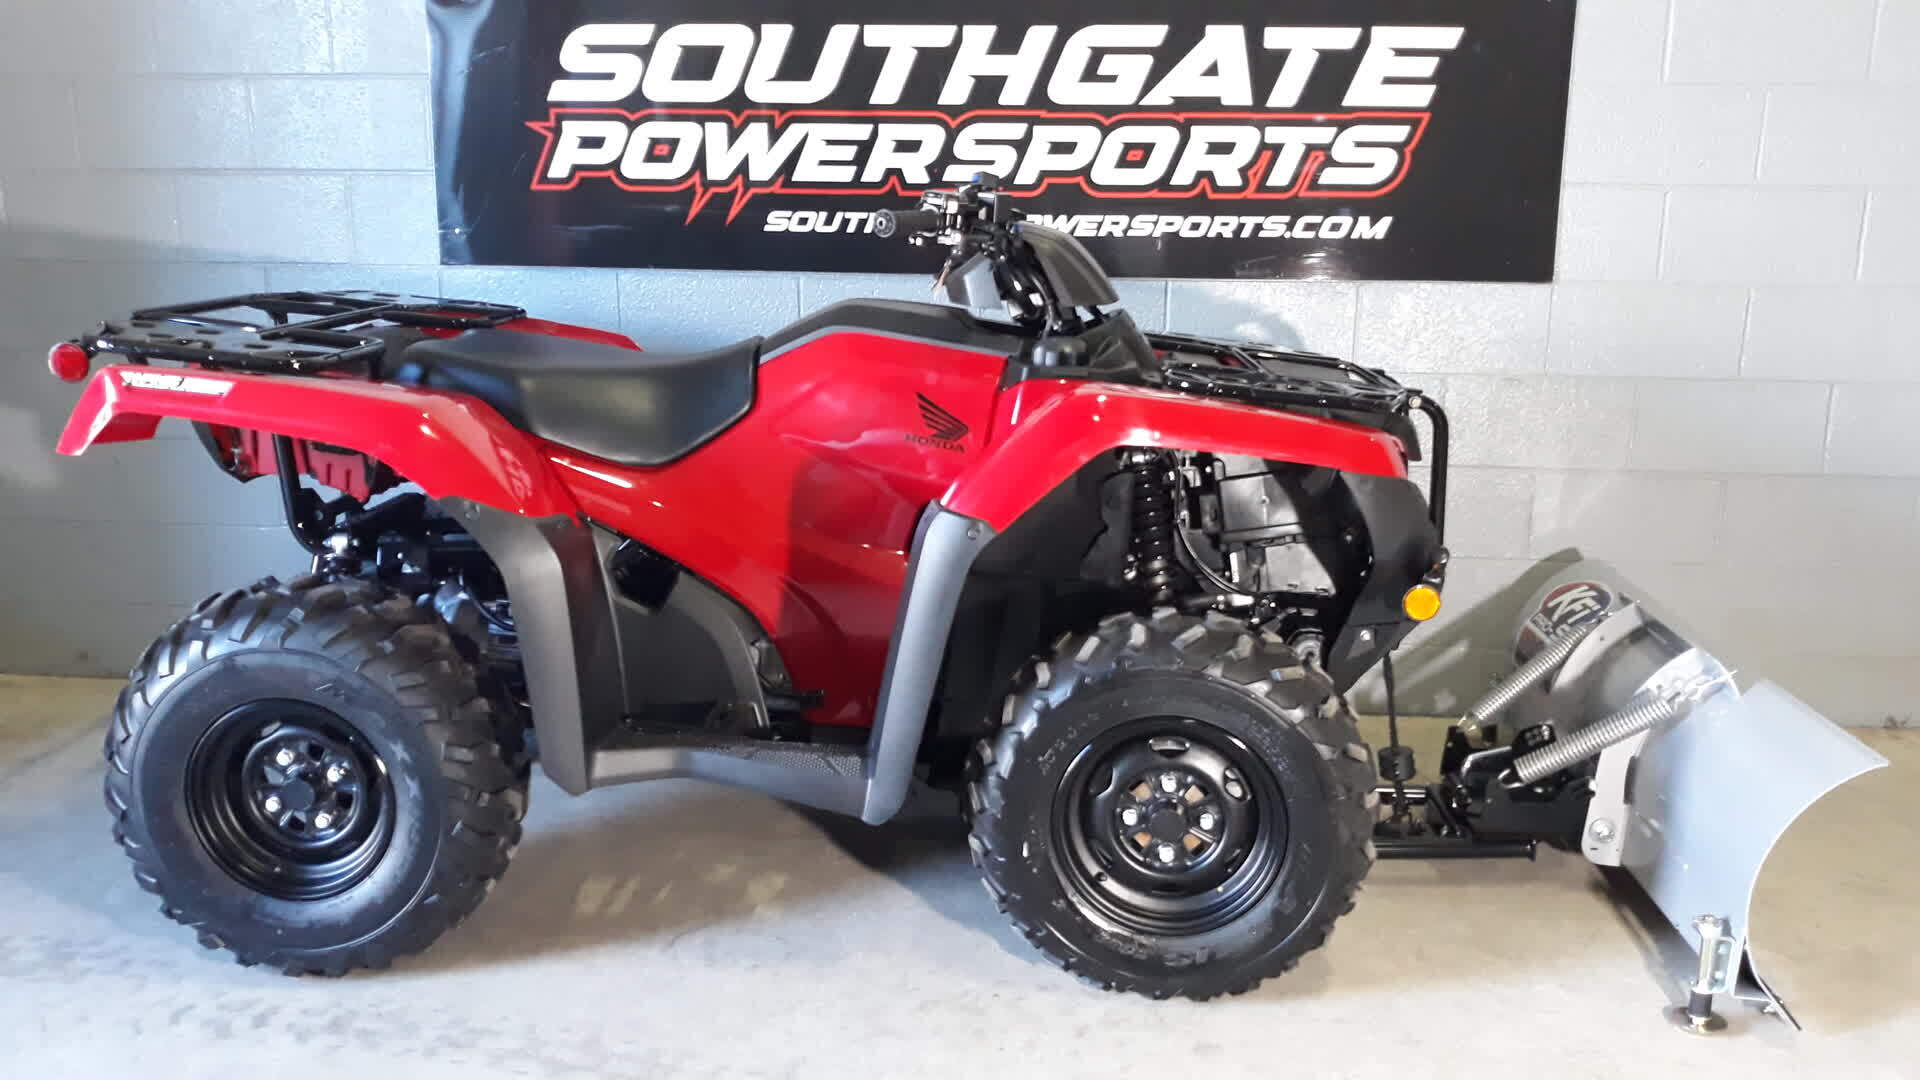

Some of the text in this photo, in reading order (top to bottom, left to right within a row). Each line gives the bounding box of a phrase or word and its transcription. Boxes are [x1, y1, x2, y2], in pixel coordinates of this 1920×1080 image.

[547, 23, 1465, 108] SOUTHGATE
[547, 120, 1411, 188] POWERSPORTS
[906, 434, 965, 452] HONDA
